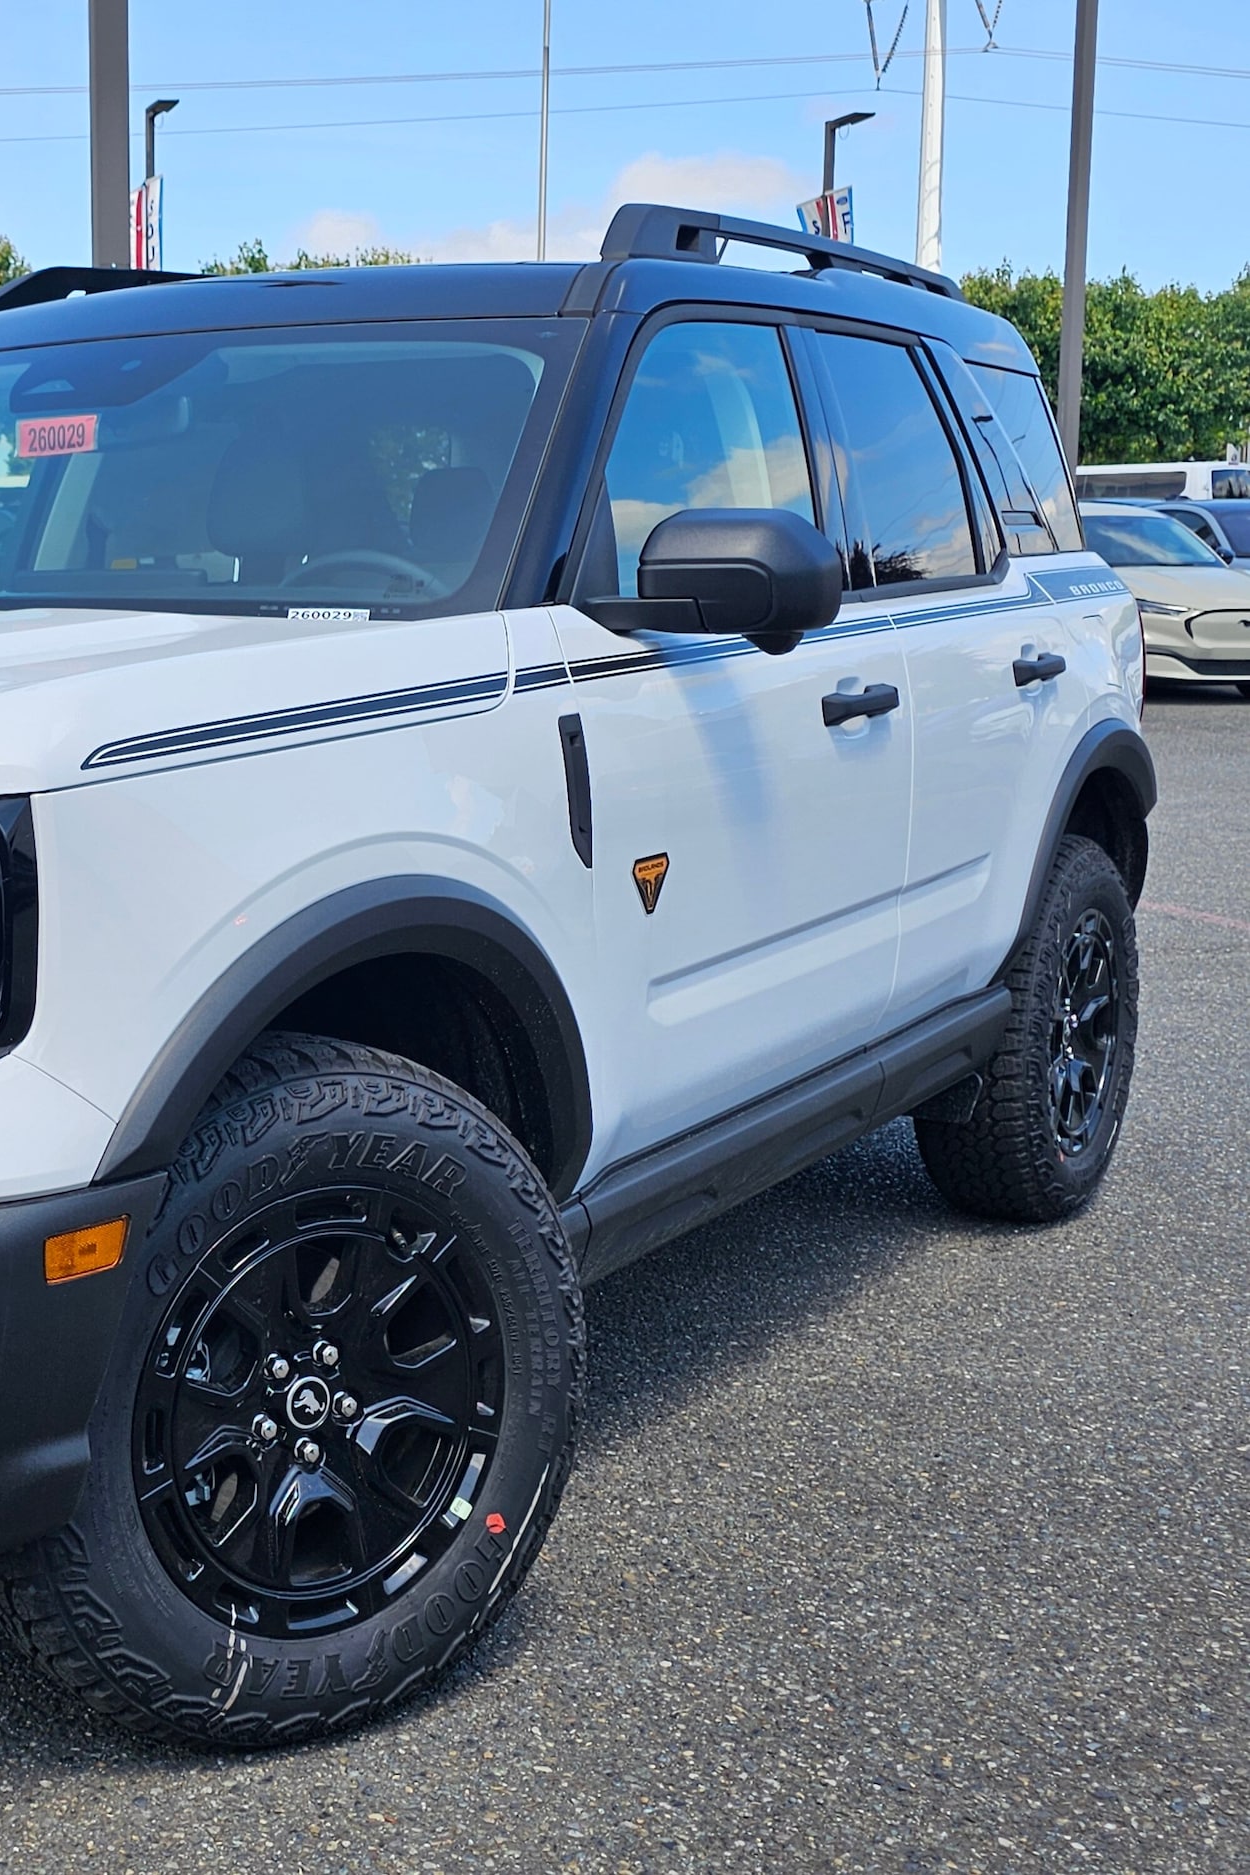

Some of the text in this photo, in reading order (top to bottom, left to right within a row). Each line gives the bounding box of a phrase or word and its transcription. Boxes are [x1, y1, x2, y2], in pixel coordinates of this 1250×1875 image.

[28, 423, 85, 452] 260029
[1068, 580, 1125, 596] BRONCO
[290, 611, 351, 620] 260029
